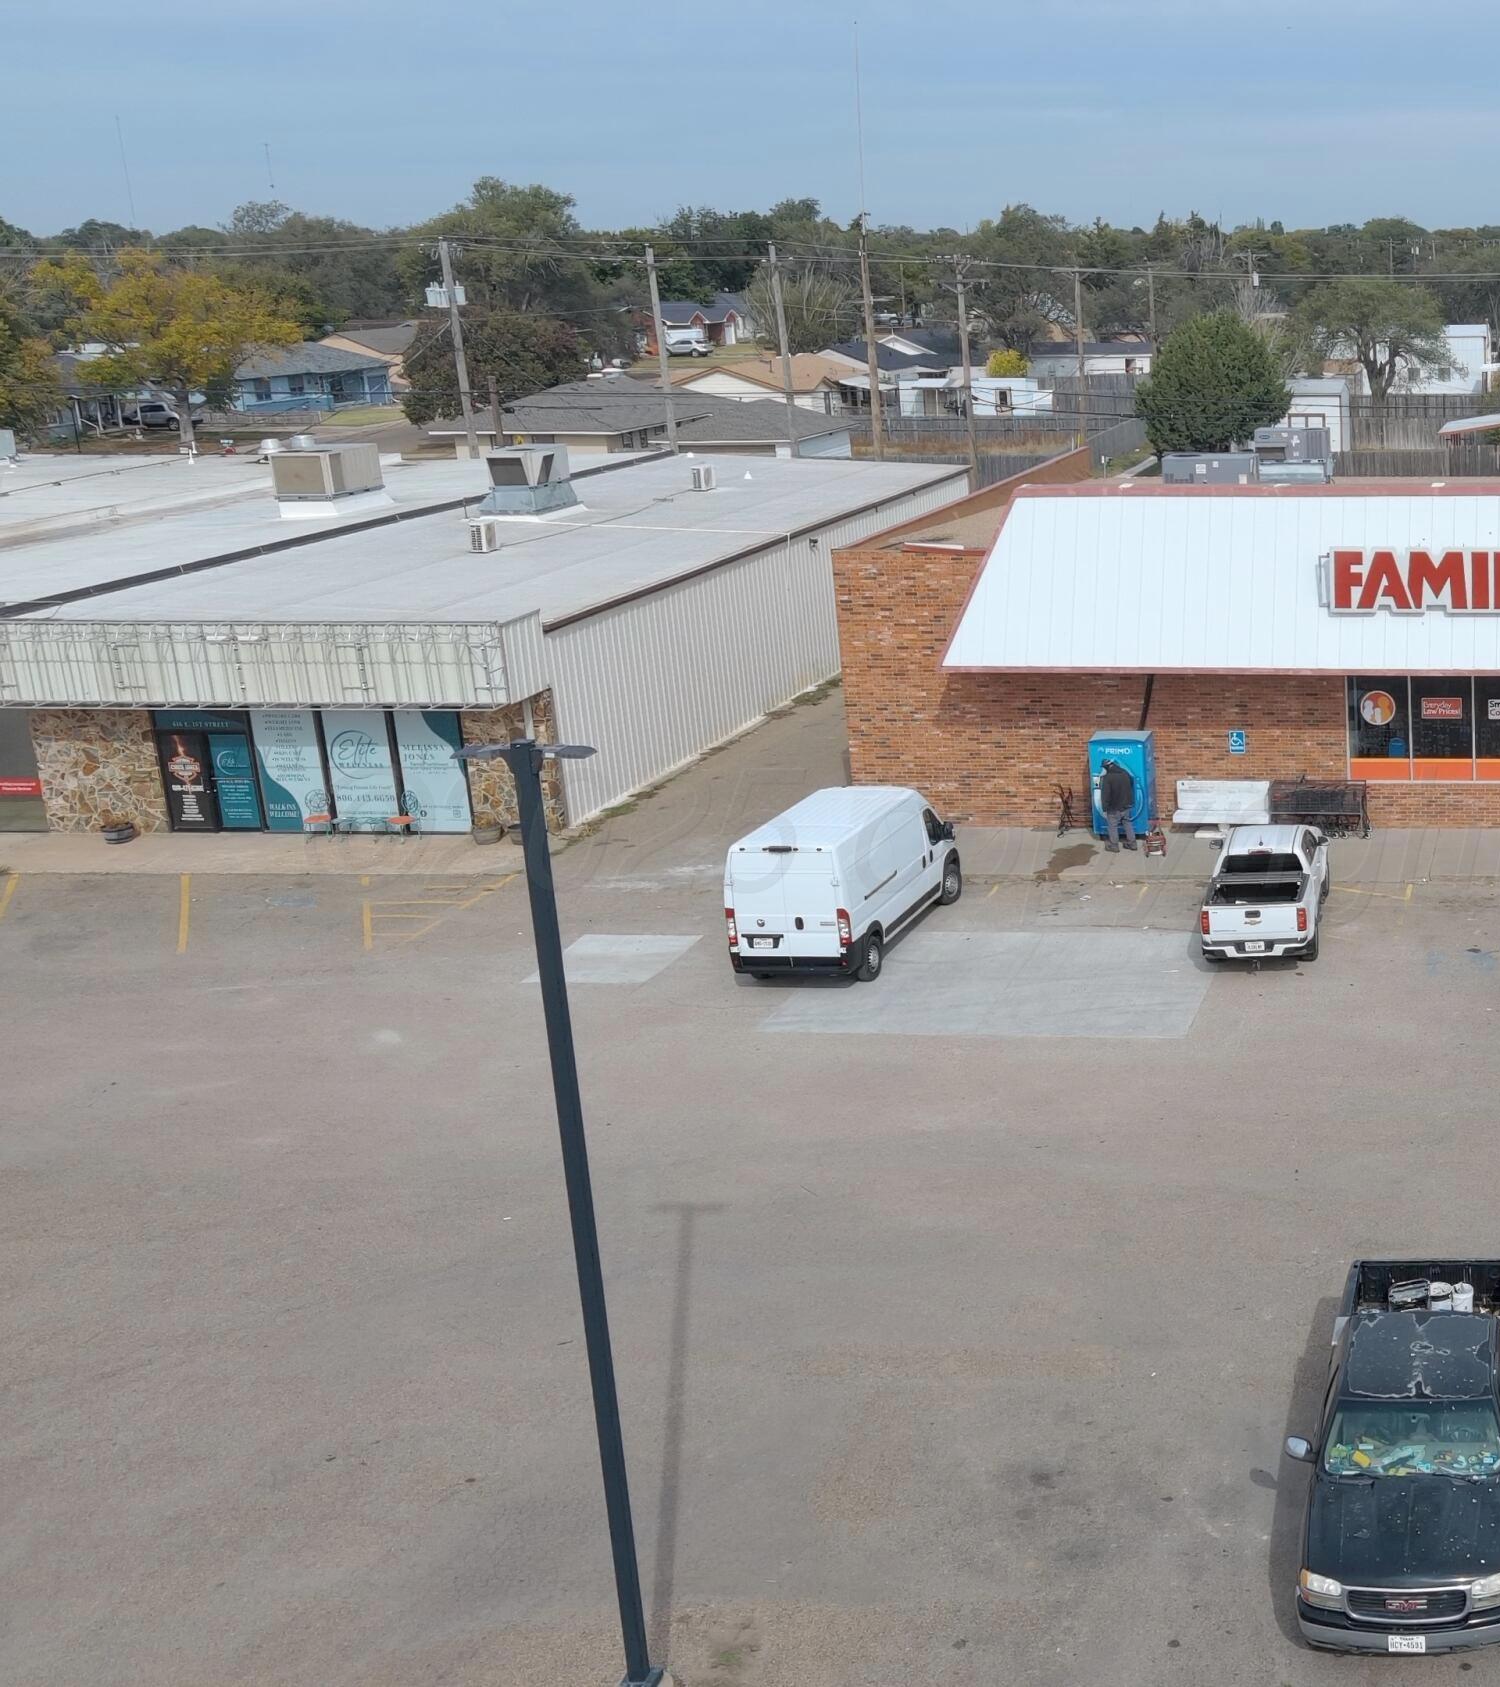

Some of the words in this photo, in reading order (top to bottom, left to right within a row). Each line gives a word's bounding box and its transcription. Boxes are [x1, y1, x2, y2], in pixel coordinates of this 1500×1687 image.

[1423, 701, 1452, 710] Everyday
[1104, 747, 1131, 755] PRIMO
[1385, 1599, 1428, 1612] GMC
